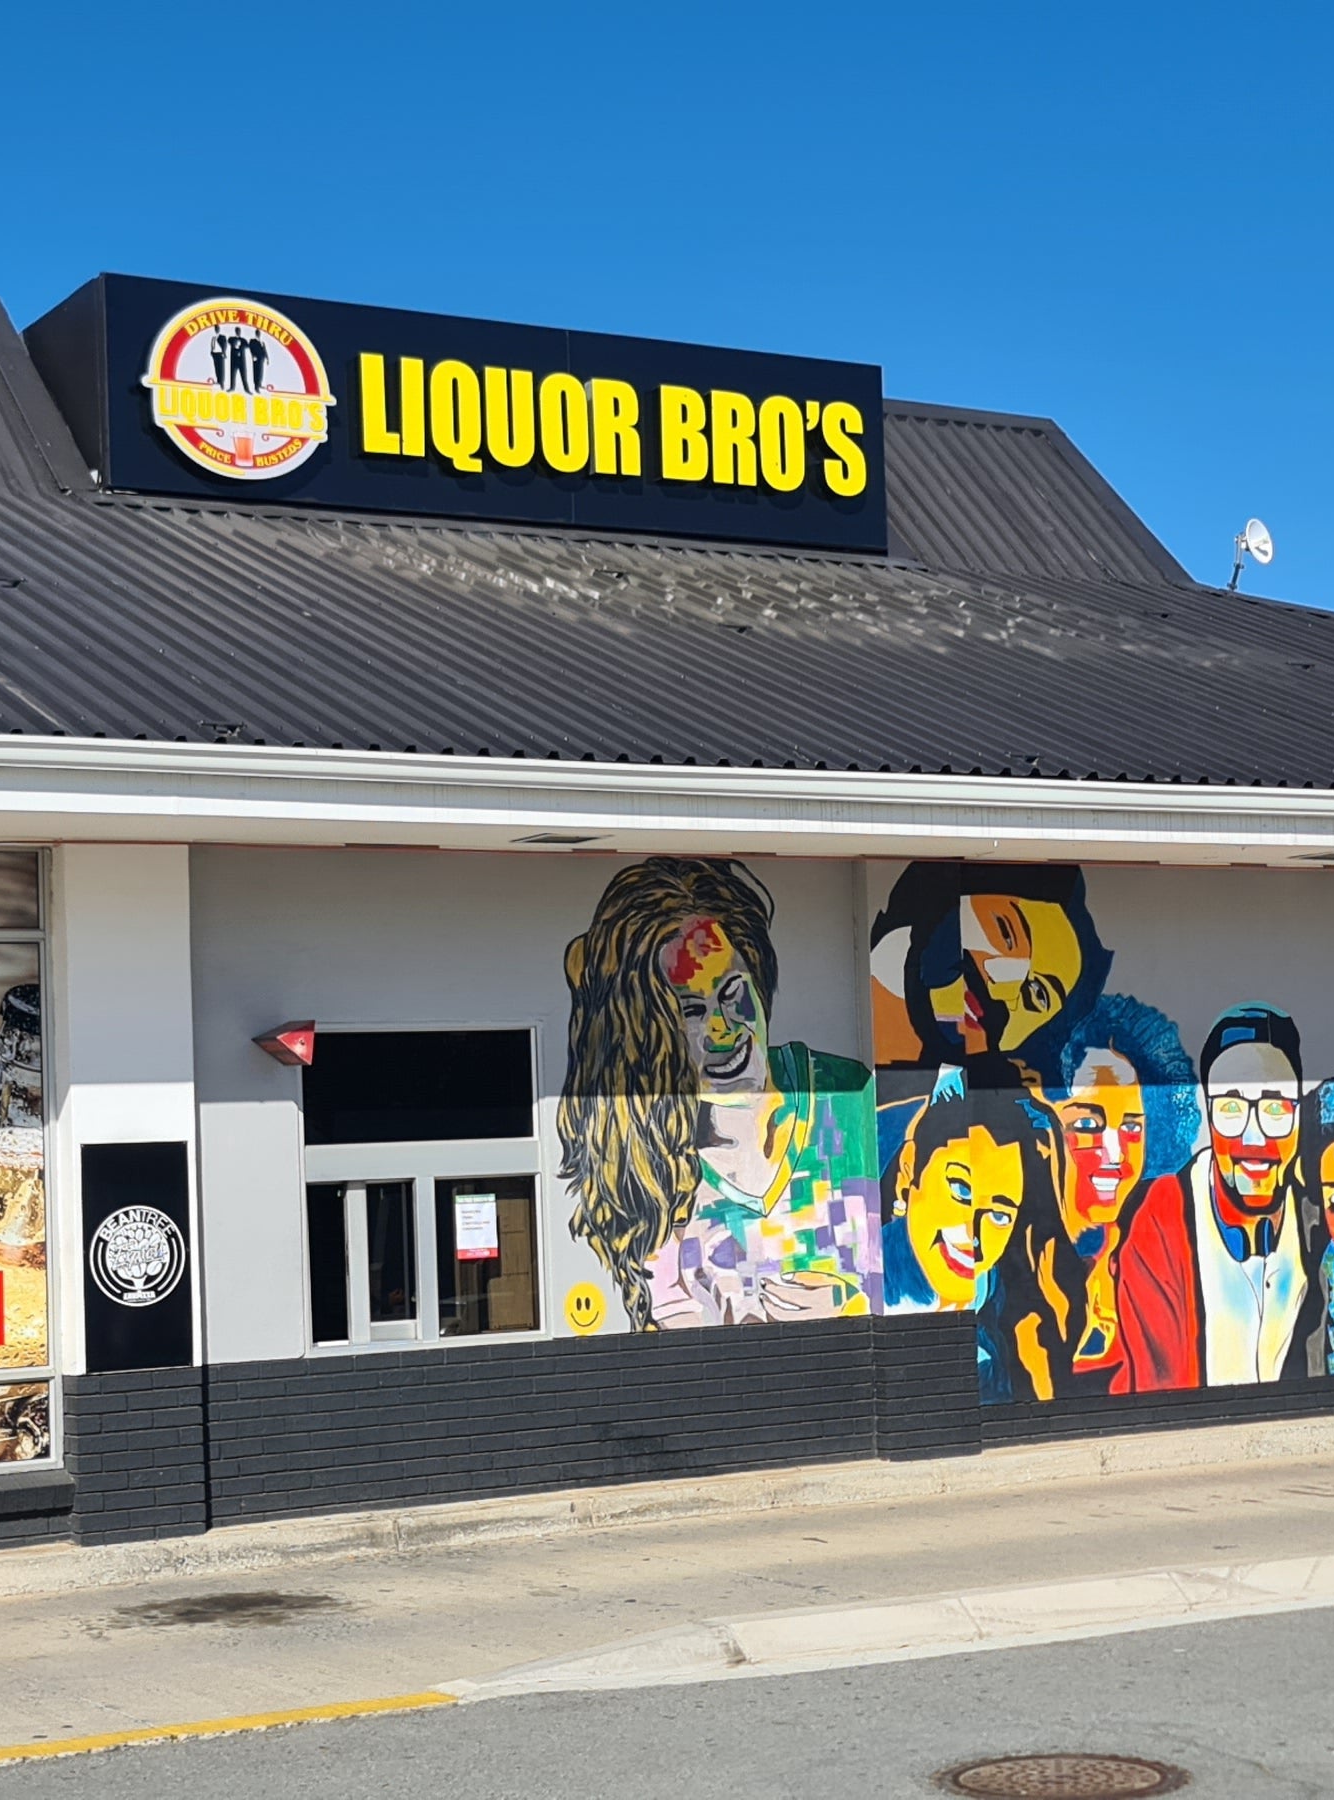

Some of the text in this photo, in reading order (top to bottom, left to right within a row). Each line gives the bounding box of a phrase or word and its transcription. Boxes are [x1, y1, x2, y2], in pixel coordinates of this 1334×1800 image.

[183, 310, 293, 346] DRIVE THRU
[159, 385, 324, 432] LIQUOR BRO'S
[359, 352, 867, 497] LIQUOR BRO'S
[99, 1209, 175, 1241] BEANTREE
